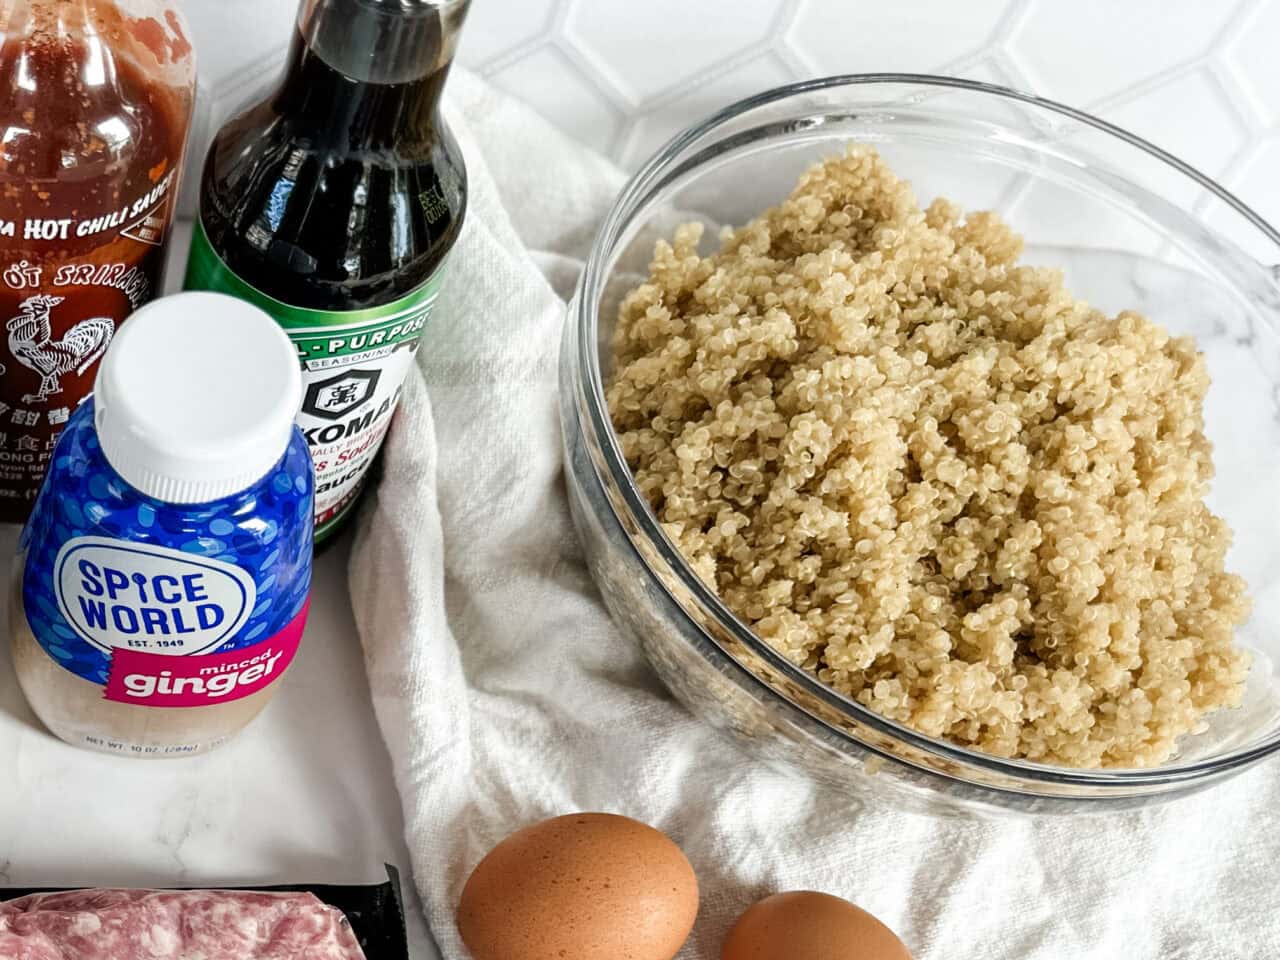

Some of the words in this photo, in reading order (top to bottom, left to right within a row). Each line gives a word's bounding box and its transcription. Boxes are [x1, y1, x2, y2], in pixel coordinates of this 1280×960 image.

[24, 219, 70, 241] HOT
[77, 207, 129, 238] CHILI
[77, 559, 210, 606] SPICE
[77, 594, 225, 636] WORLD
[128, 639, 152, 648] EST.
[157, 639, 184, 647] 1949
[199, 648, 272, 675] minced
[123, 650, 283, 698] ginger
